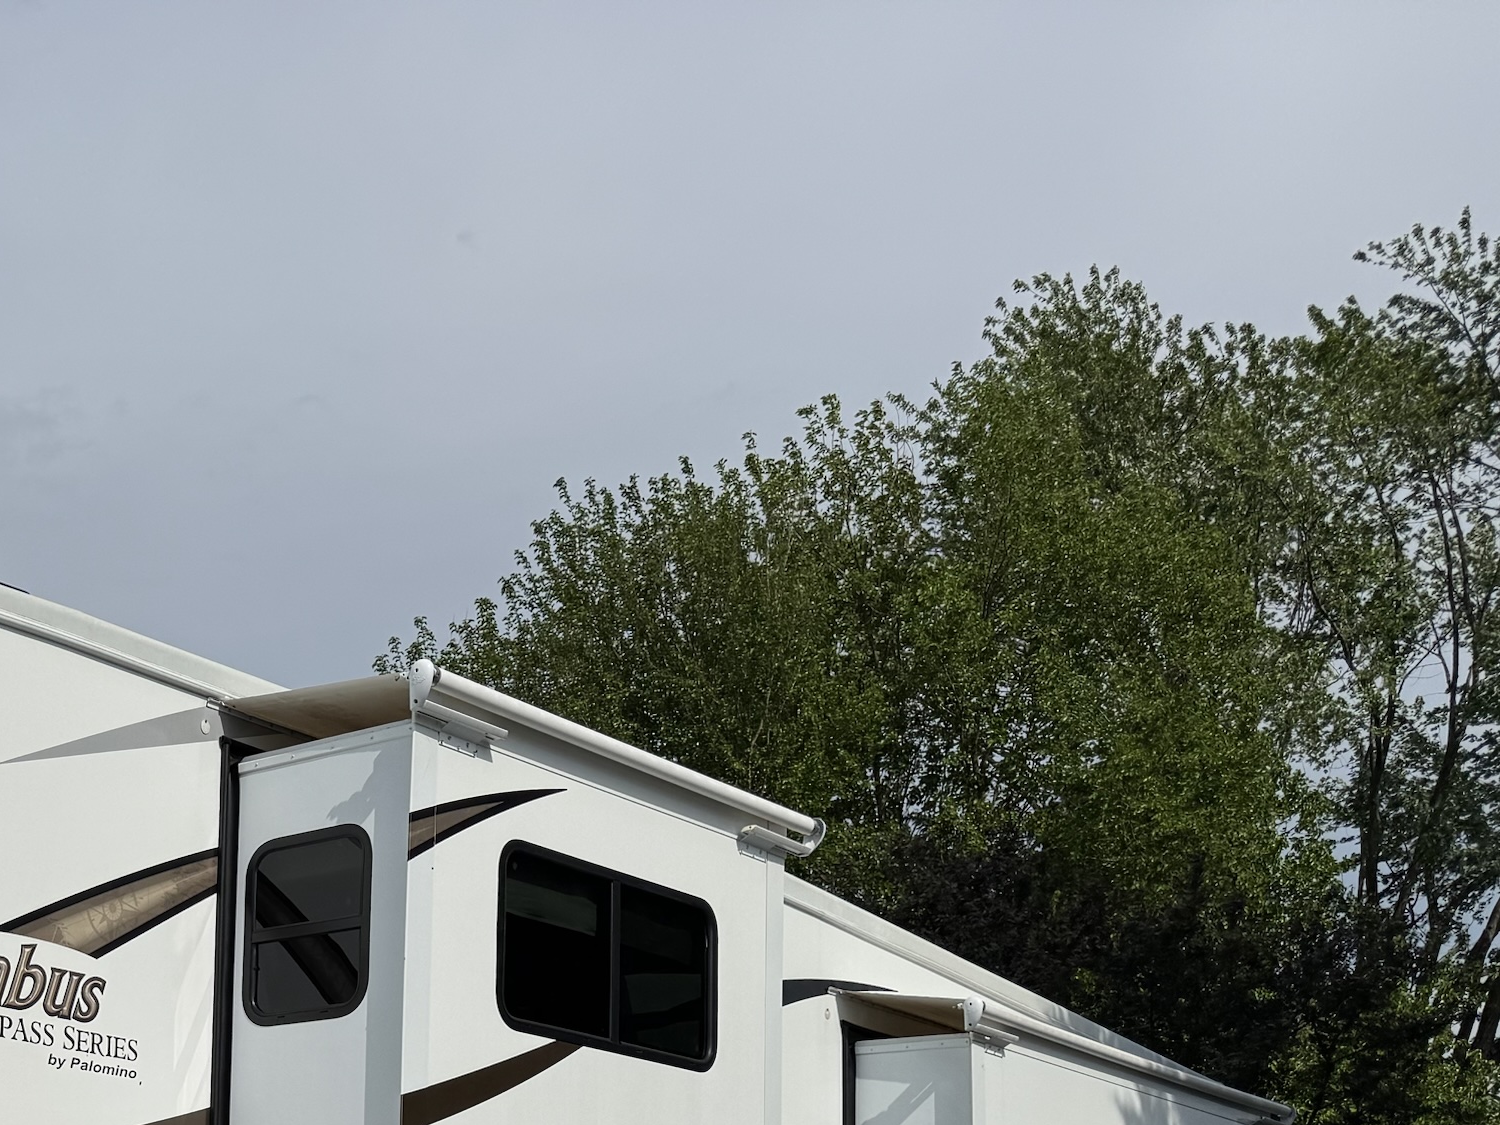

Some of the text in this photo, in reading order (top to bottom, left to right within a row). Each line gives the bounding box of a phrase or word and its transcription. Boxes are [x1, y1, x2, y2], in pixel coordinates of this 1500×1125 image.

[62, 1025, 139, 1062] SERIES
[47, 1053, 138, 1080] by Palomino
